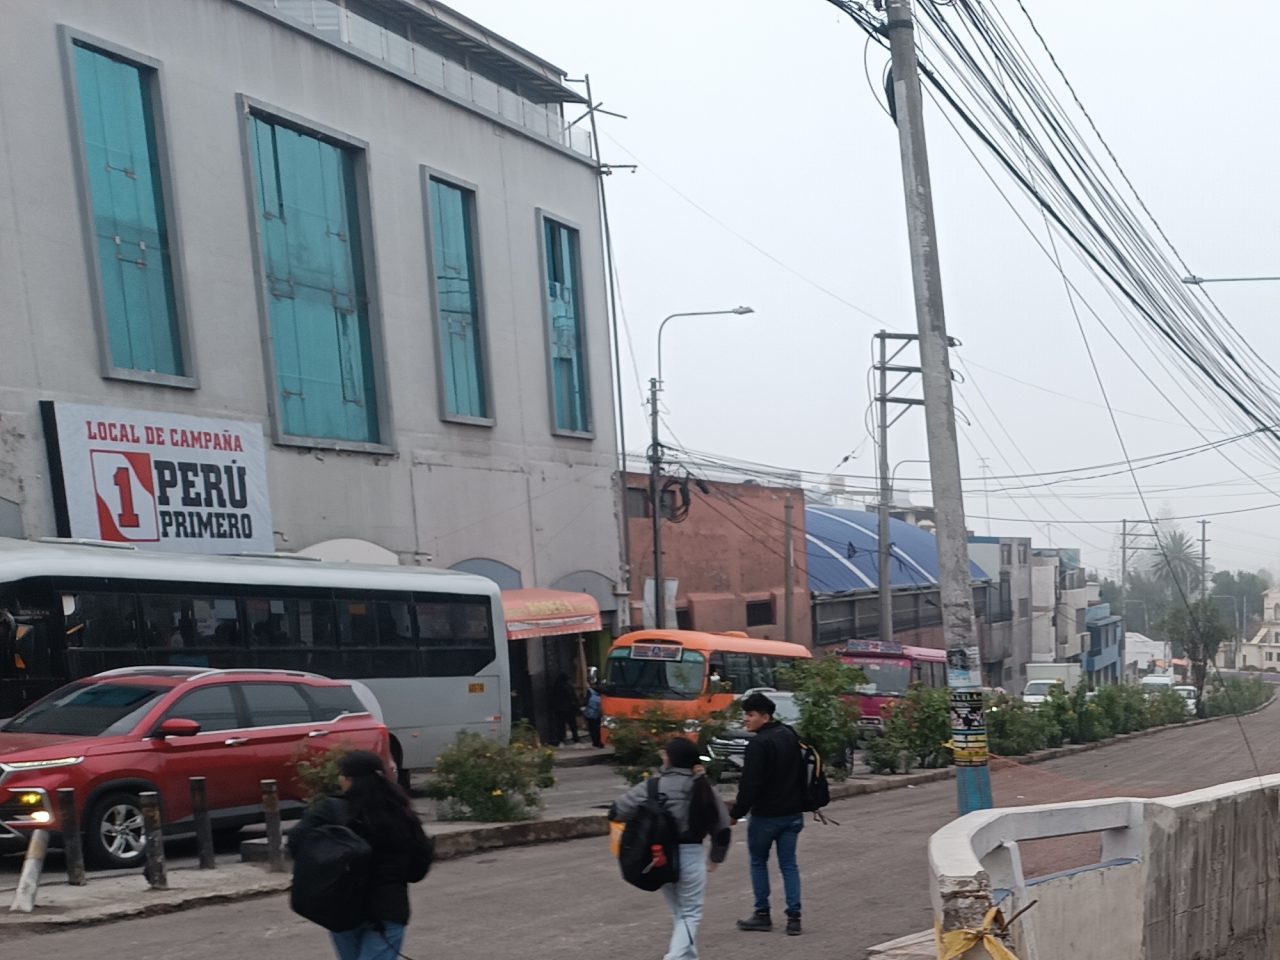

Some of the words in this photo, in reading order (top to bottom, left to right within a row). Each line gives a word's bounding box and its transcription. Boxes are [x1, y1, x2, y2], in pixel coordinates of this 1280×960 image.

[86, 420, 141, 444] LOCAL
[145, 425, 166, 446] DE
[170, 428, 244, 453] CAMPAÑA
[113, 466, 140, 528] 1
[154, 459, 248, 509] PERÚ
[159, 510, 253, 539] PRIMERO
